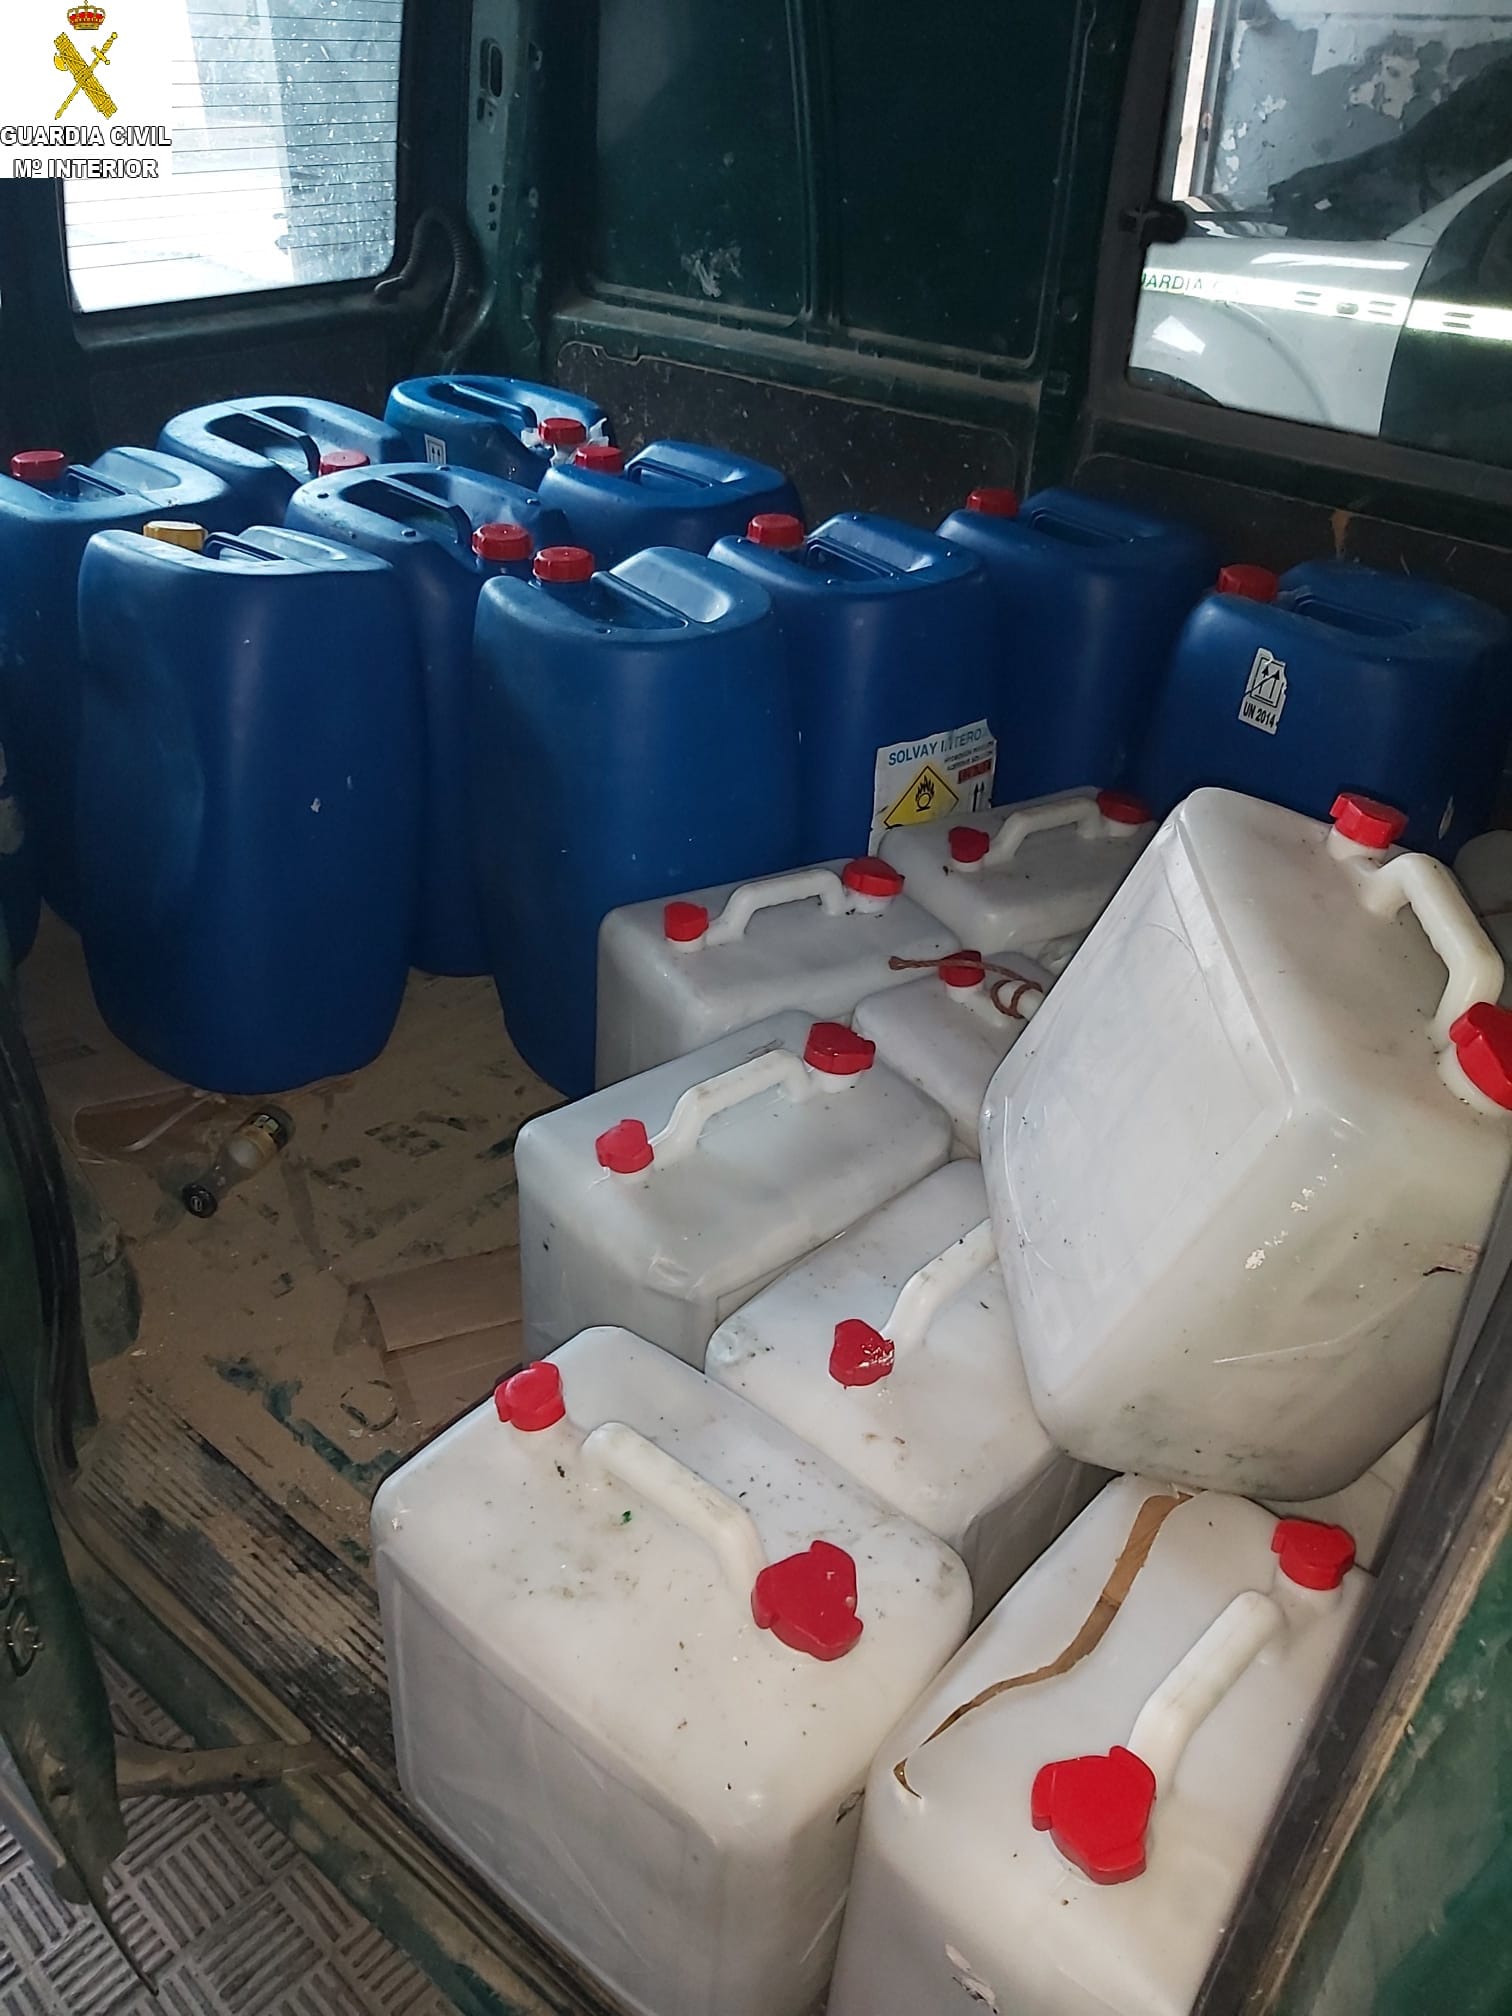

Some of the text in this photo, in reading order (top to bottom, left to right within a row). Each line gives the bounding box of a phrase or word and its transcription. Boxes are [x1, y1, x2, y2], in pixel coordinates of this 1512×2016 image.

[1243, 701, 1276, 728] UN 2014
[889, 741, 938, 766] SOLVAY
